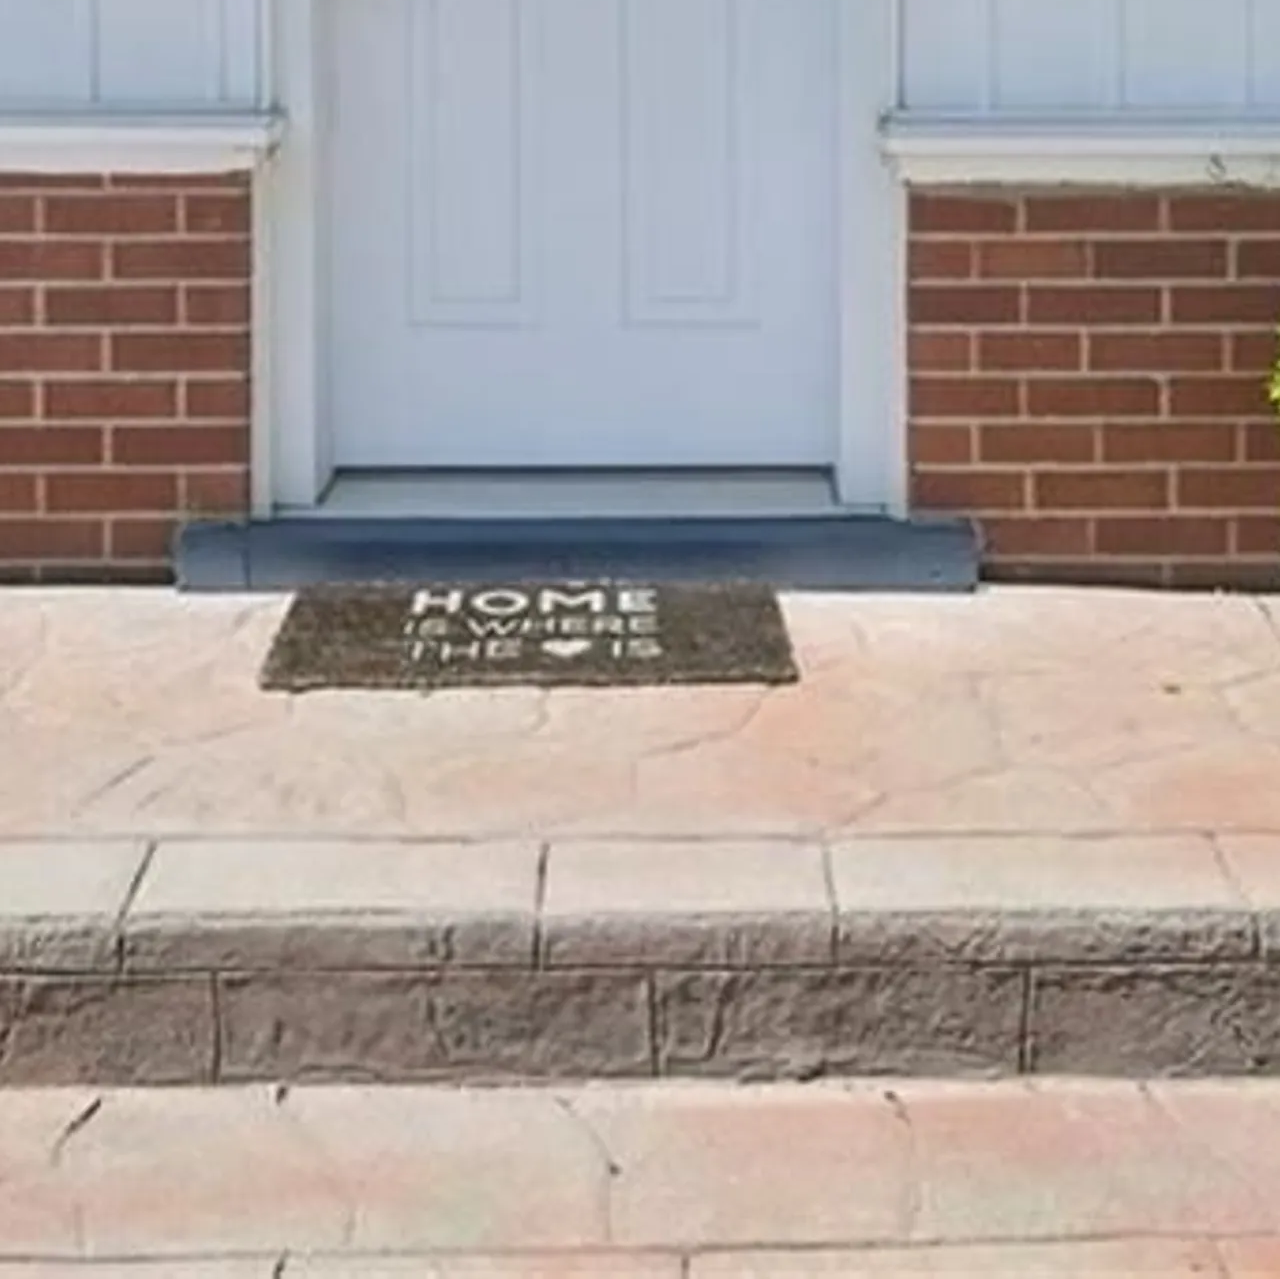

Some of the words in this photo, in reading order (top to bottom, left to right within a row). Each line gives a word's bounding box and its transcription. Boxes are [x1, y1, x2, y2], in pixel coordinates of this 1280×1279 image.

[410, 589, 658, 614] HOME
[468, 617, 659, 637] WHERE
[406, 639, 522, 662] THE
[611, 639, 663, 659] IS
